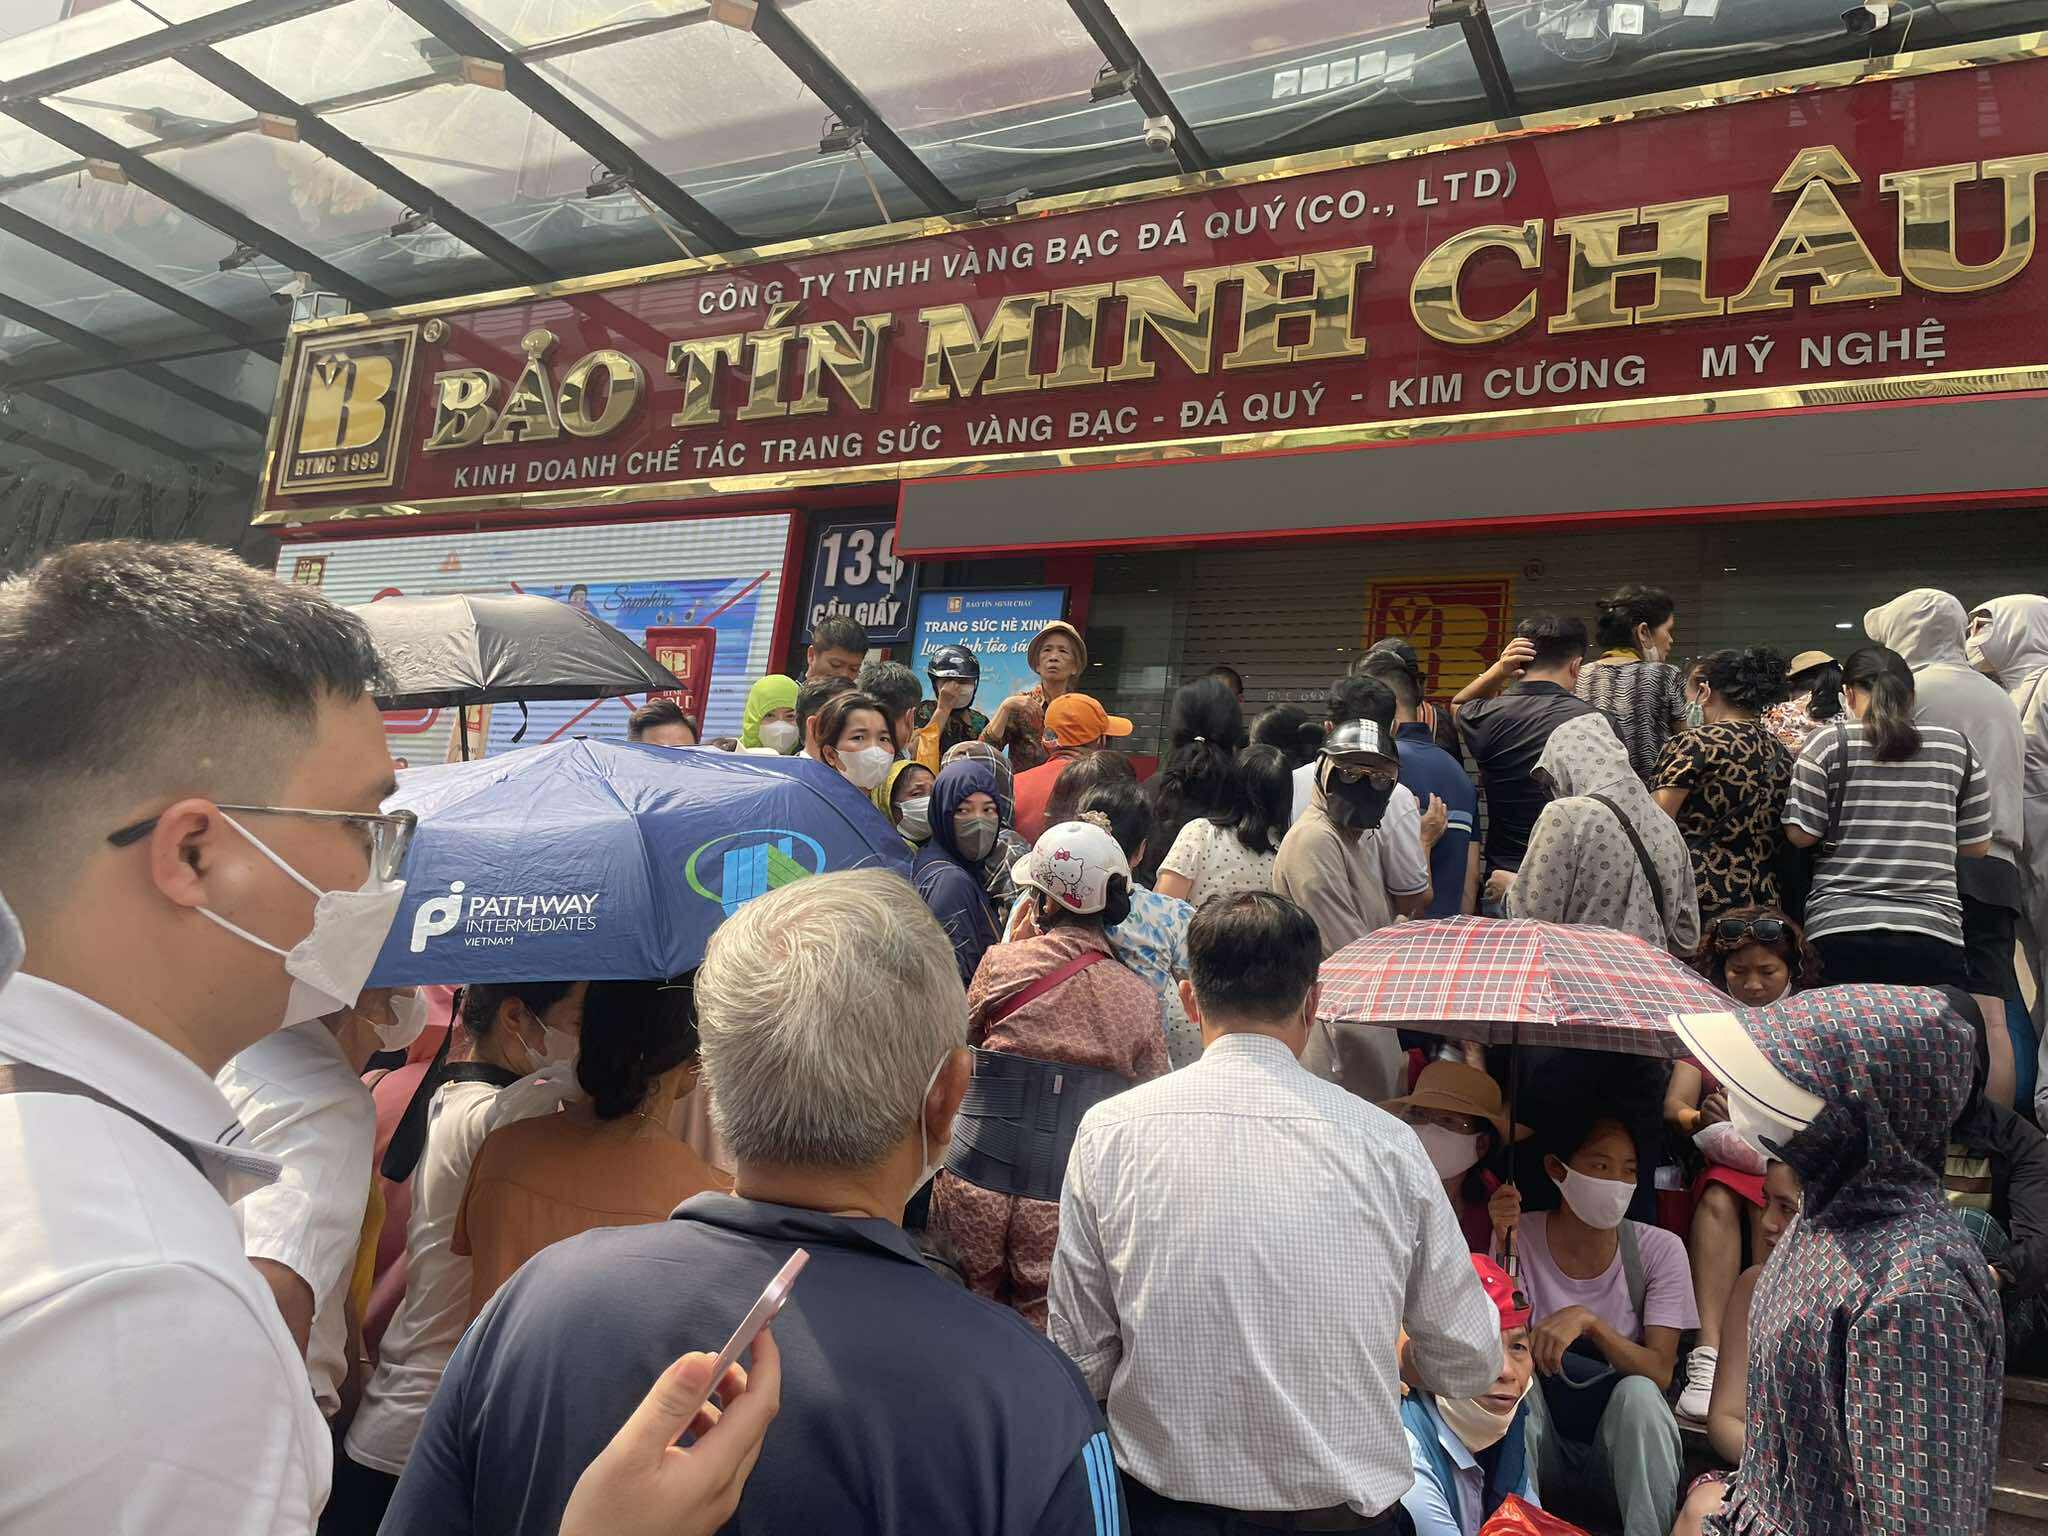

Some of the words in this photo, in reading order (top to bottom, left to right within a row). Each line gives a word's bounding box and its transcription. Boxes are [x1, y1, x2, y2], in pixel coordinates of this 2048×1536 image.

[698, 281, 784, 315] CÔNG
[800, 273, 834, 299] TY
[844, 258, 930, 292] TNHH
[943, 245, 1034, 279] VÀNG
[1046, 229, 1120, 265] BẠC
[1138, 211, 1187, 249] ĐÁ
[1204, 195, 1286, 239] QUÝ
[1417, 161, 1517, 207] LTD)
[423, 328, 645, 451] BẢO
[666, 300, 892, 428] TÍN
[909, 245, 1373, 403] MINH
[1409, 144, 2048, 345] CHÂU
[454, 463, 516, 488] KINH
[526, 454, 617, 483] DOANH
[626, 439, 684, 475] CHẾ
[693, 439, 746, 470] TÁC
[761, 432, 863, 464] TRANG
[876, 421, 943, 455] SỨC
[966, 413, 1053, 447] VÀNG
[1067, 406, 1138, 442] BẠC
[1180, 391, 1229, 428] ĐÁ
[1242, 381, 1326, 421] QUÝ
[1388, 372, 1463, 409] KIM
[1483, 354, 1647, 400] CƯƠNG
[1702, 334, 1775, 379] MỸ
[1800, 317, 1947, 369] NGHỆ
[295, 455, 336, 476] BTMC
[822, 529, 904, 586] 139
[855, 593, 900, 626] GIẤY
[925, 621, 968, 632] TRANG
[971, 617, 998, 632] SỨC
[1001, 617, 1017, 631] HÈ
[1011, 638, 1029, 653] sá
[469, 893, 600, 917] PATHWAY
[465, 916, 597, 934] INTERMEDIATES
[464, 936, 514, 947] VIETNAM
